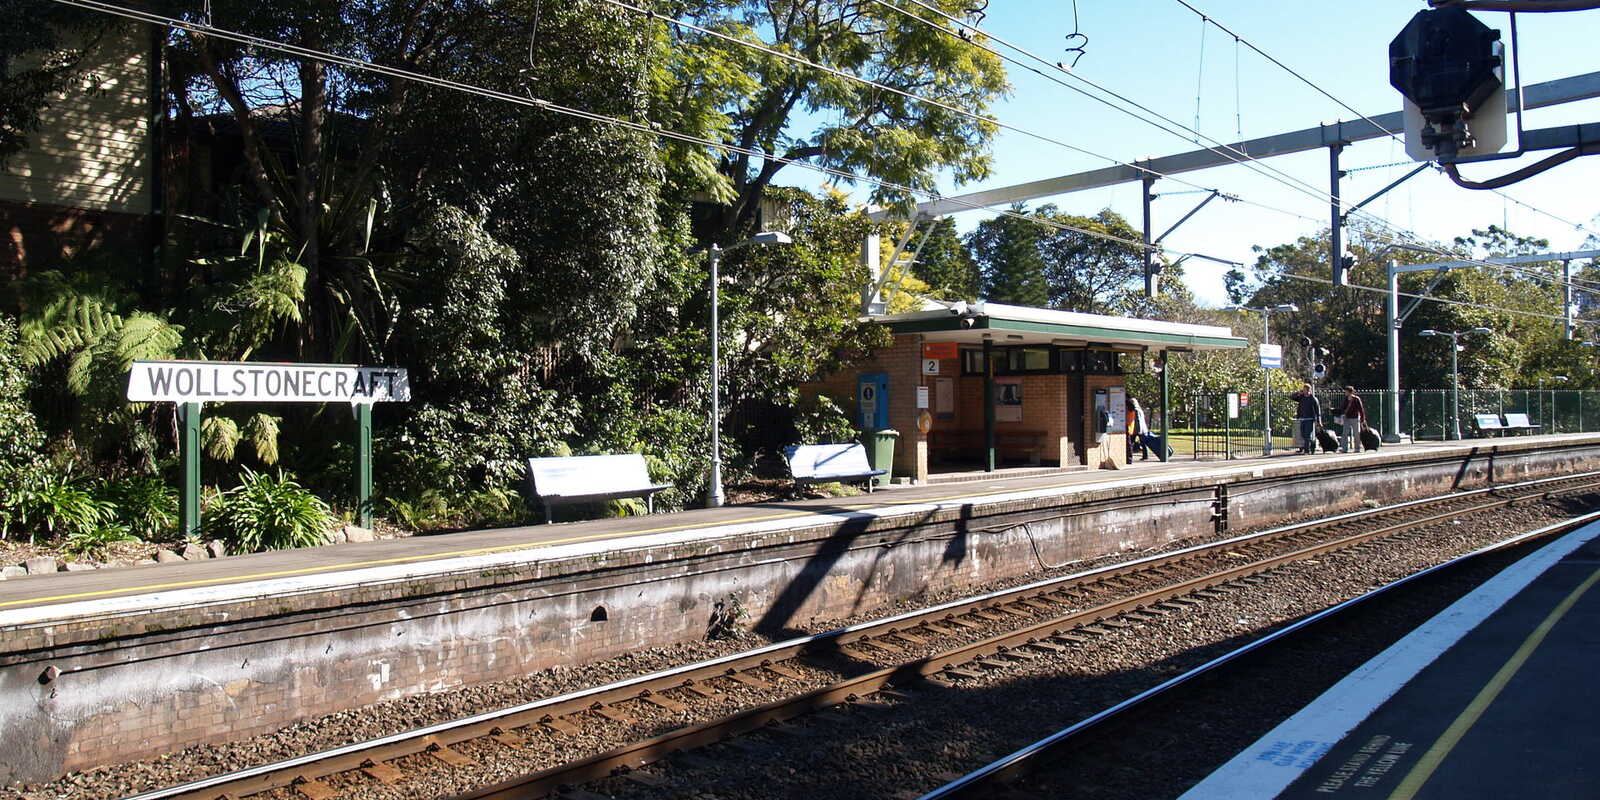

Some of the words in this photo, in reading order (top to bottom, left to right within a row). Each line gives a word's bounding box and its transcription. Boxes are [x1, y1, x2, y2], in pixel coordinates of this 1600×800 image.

[928, 360, 936, 371] 2
[147, 367, 398, 397] WOLLSTONECRAFT
[1315, 771, 1354, 793] PLEASE
[1353, 776, 1380, 787] THE
